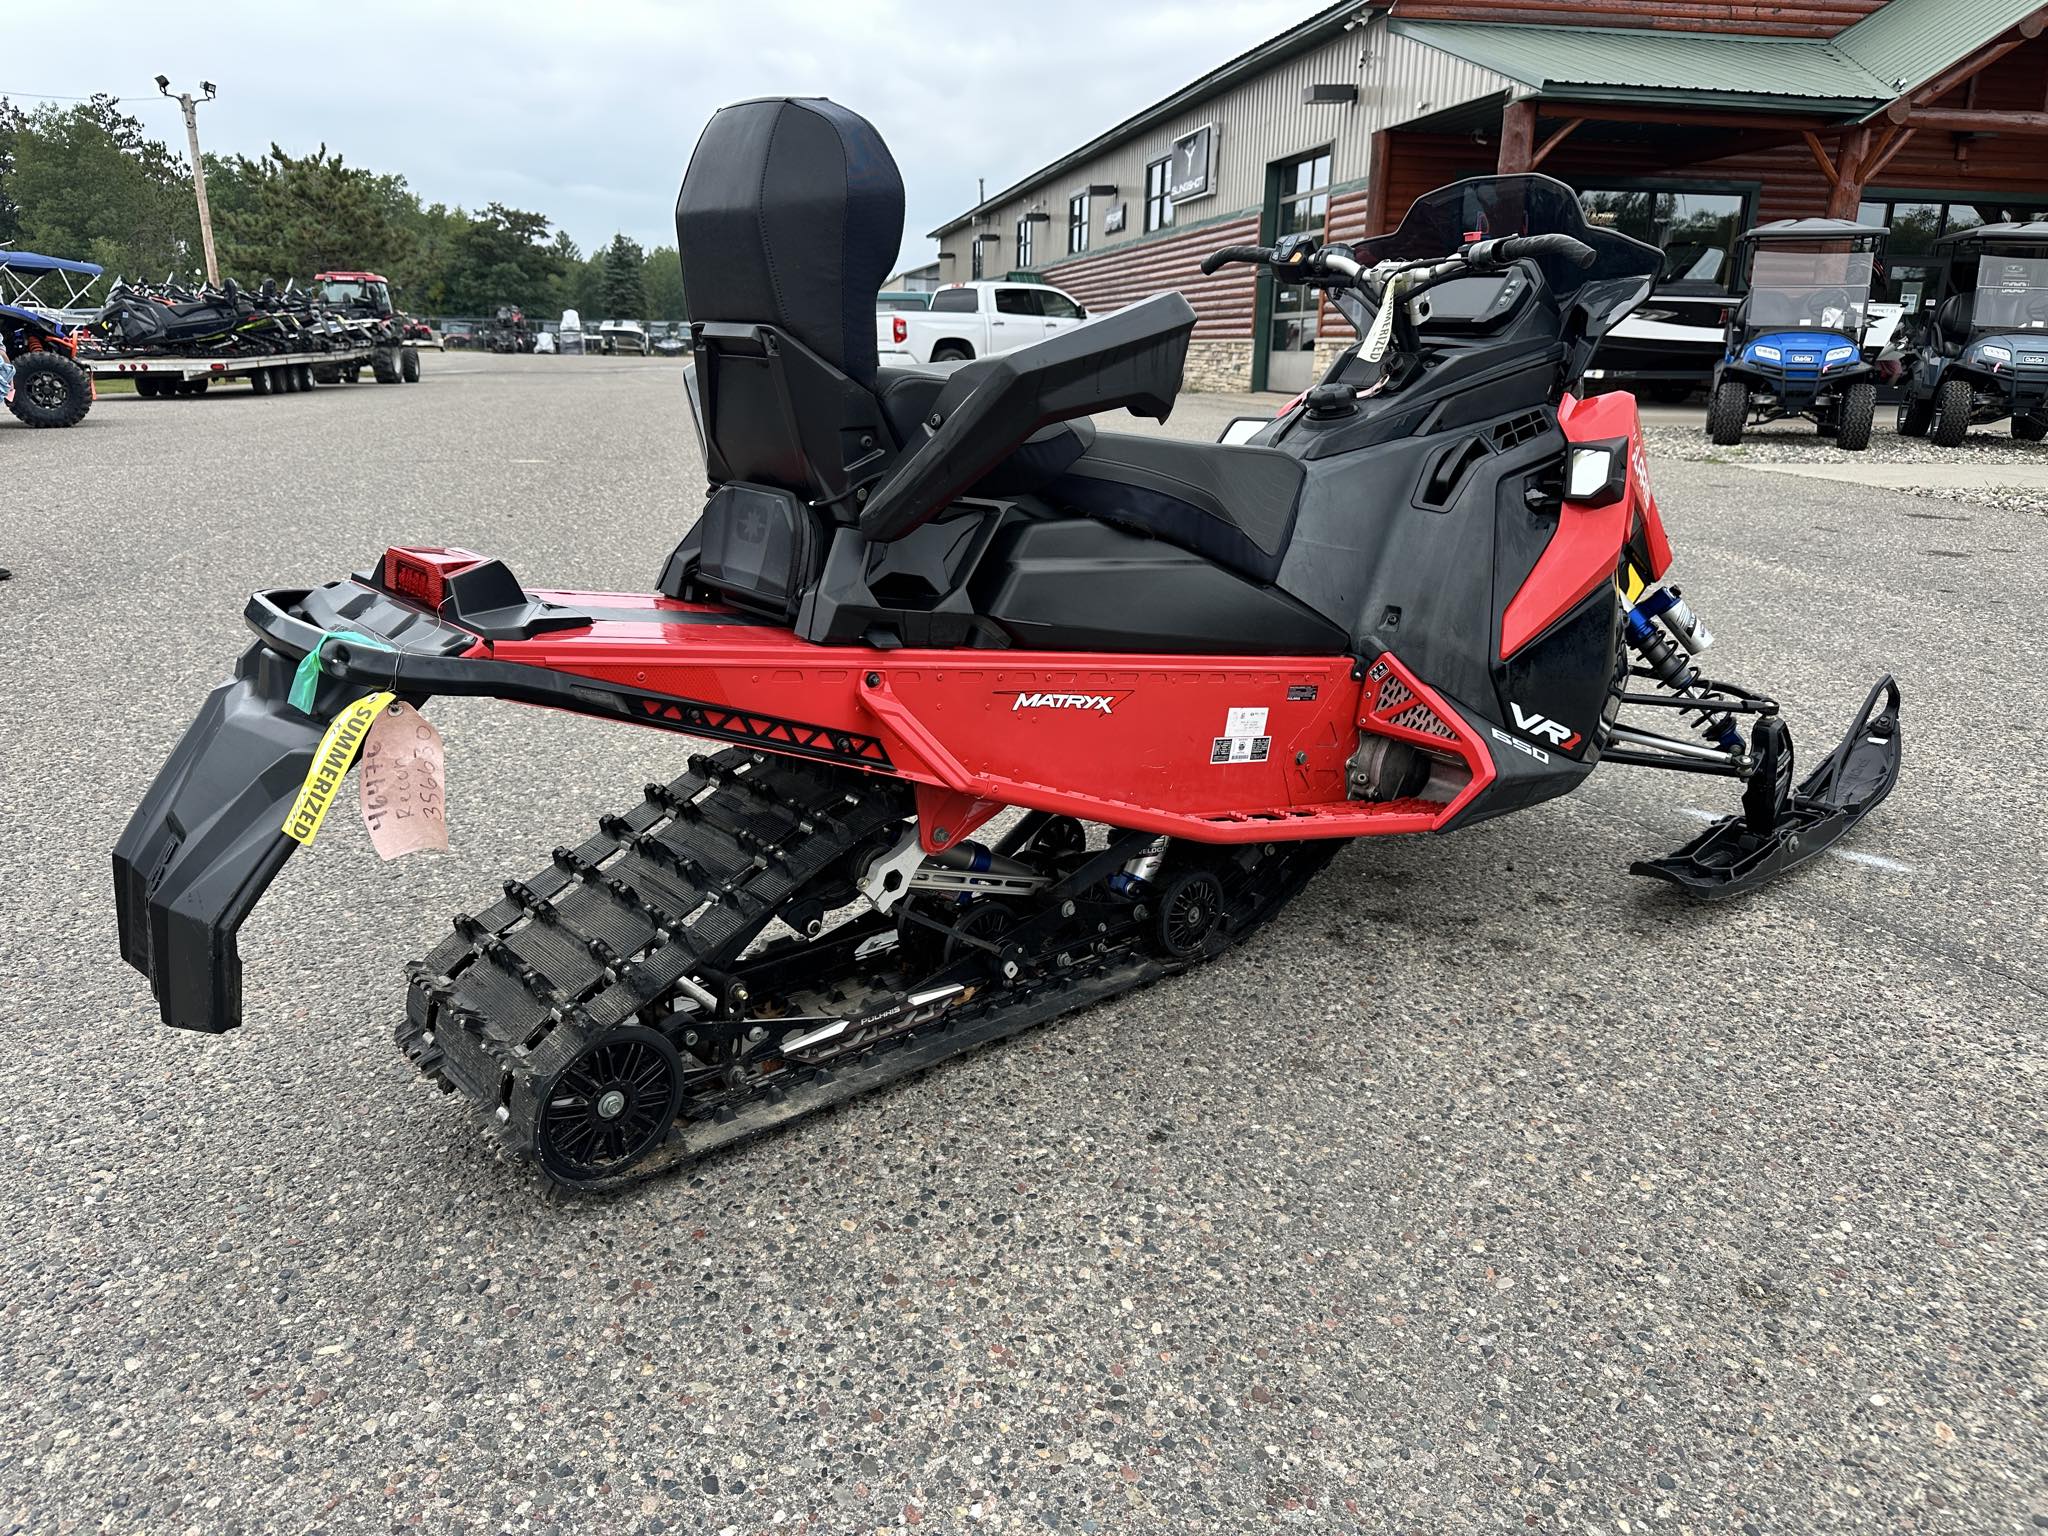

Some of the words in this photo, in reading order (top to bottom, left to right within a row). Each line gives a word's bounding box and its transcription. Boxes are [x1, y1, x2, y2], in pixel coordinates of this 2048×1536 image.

[1011, 692, 1114, 714] MATRYX
[1491, 727, 1549, 765] 650
[1509, 701, 1582, 751] VR1
[293, 706, 373, 839] SUMMERIZED
[393, 758, 415, 820] Recon
[860, 1005, 901, 1026] POLARIS
